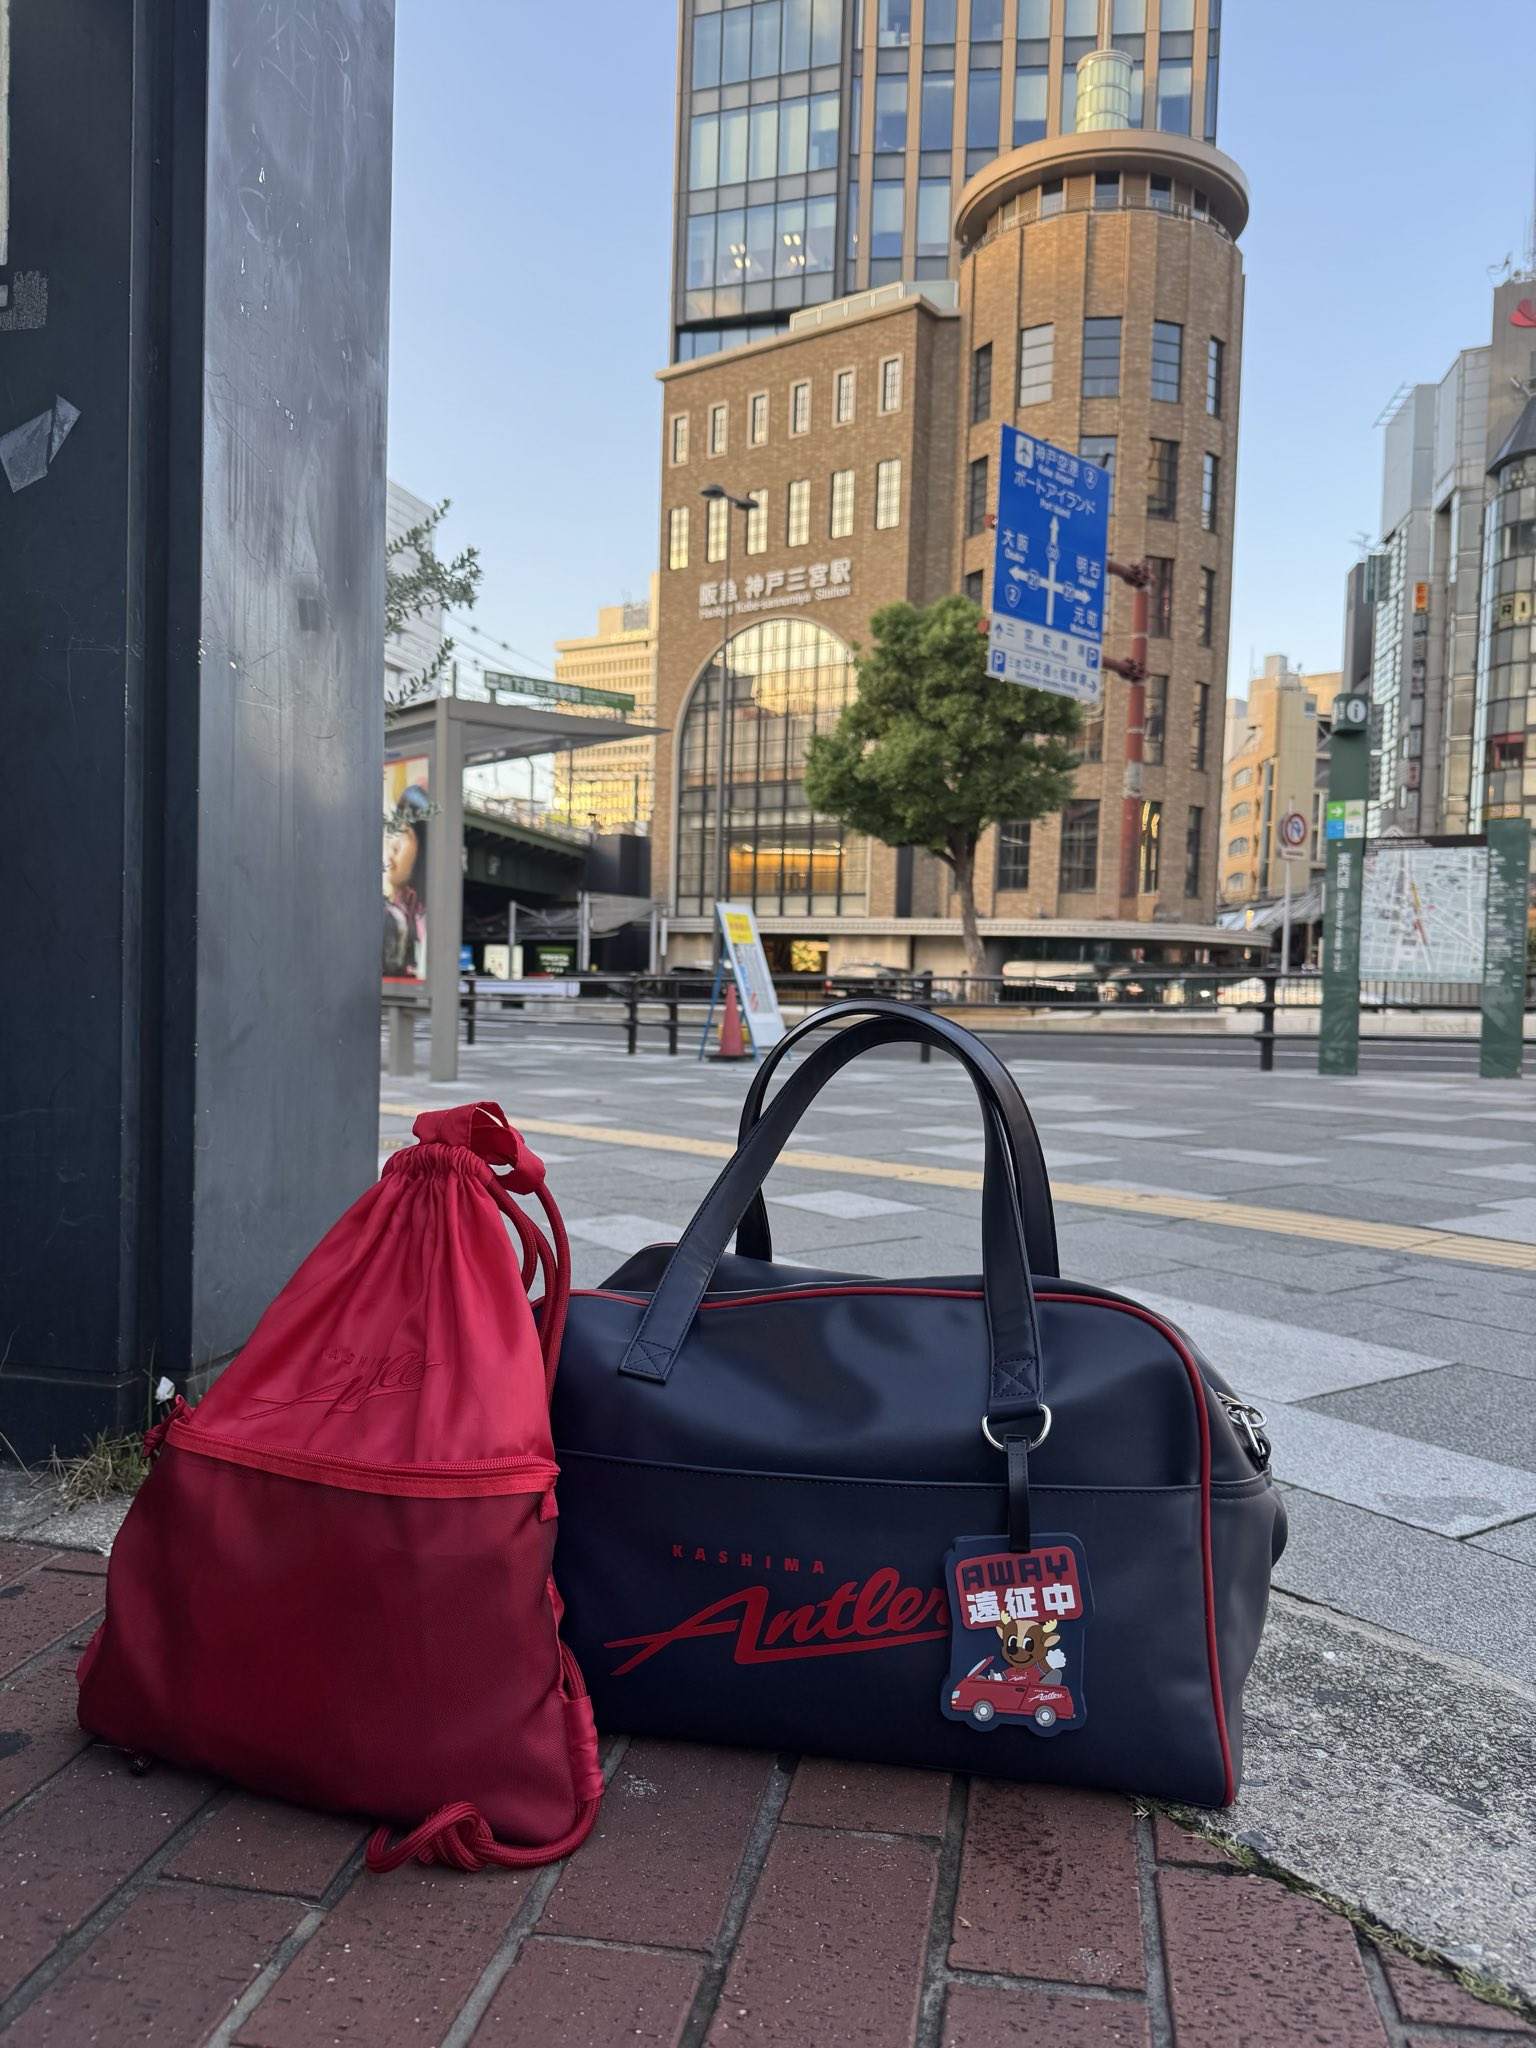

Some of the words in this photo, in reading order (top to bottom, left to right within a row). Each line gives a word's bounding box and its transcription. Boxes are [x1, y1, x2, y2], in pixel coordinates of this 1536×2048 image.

[1035, 444, 1079, 478] 神戸空港
[1014, 470, 1096, 515] ポートアイランド
[1002, 529, 1029, 553] 大阪
[745, 556, 852, 599] 神戸三宮駅
[1076, 556, 1101, 579] 明石
[1073, 606, 1098, 628] 元町
[672, 1544, 827, 1575] KASHIMA
[961, 1553, 1069, 1591] AWAY
[966, 1582, 1076, 1625] 遠征中
[603, 1566, 951, 1678] Antler
